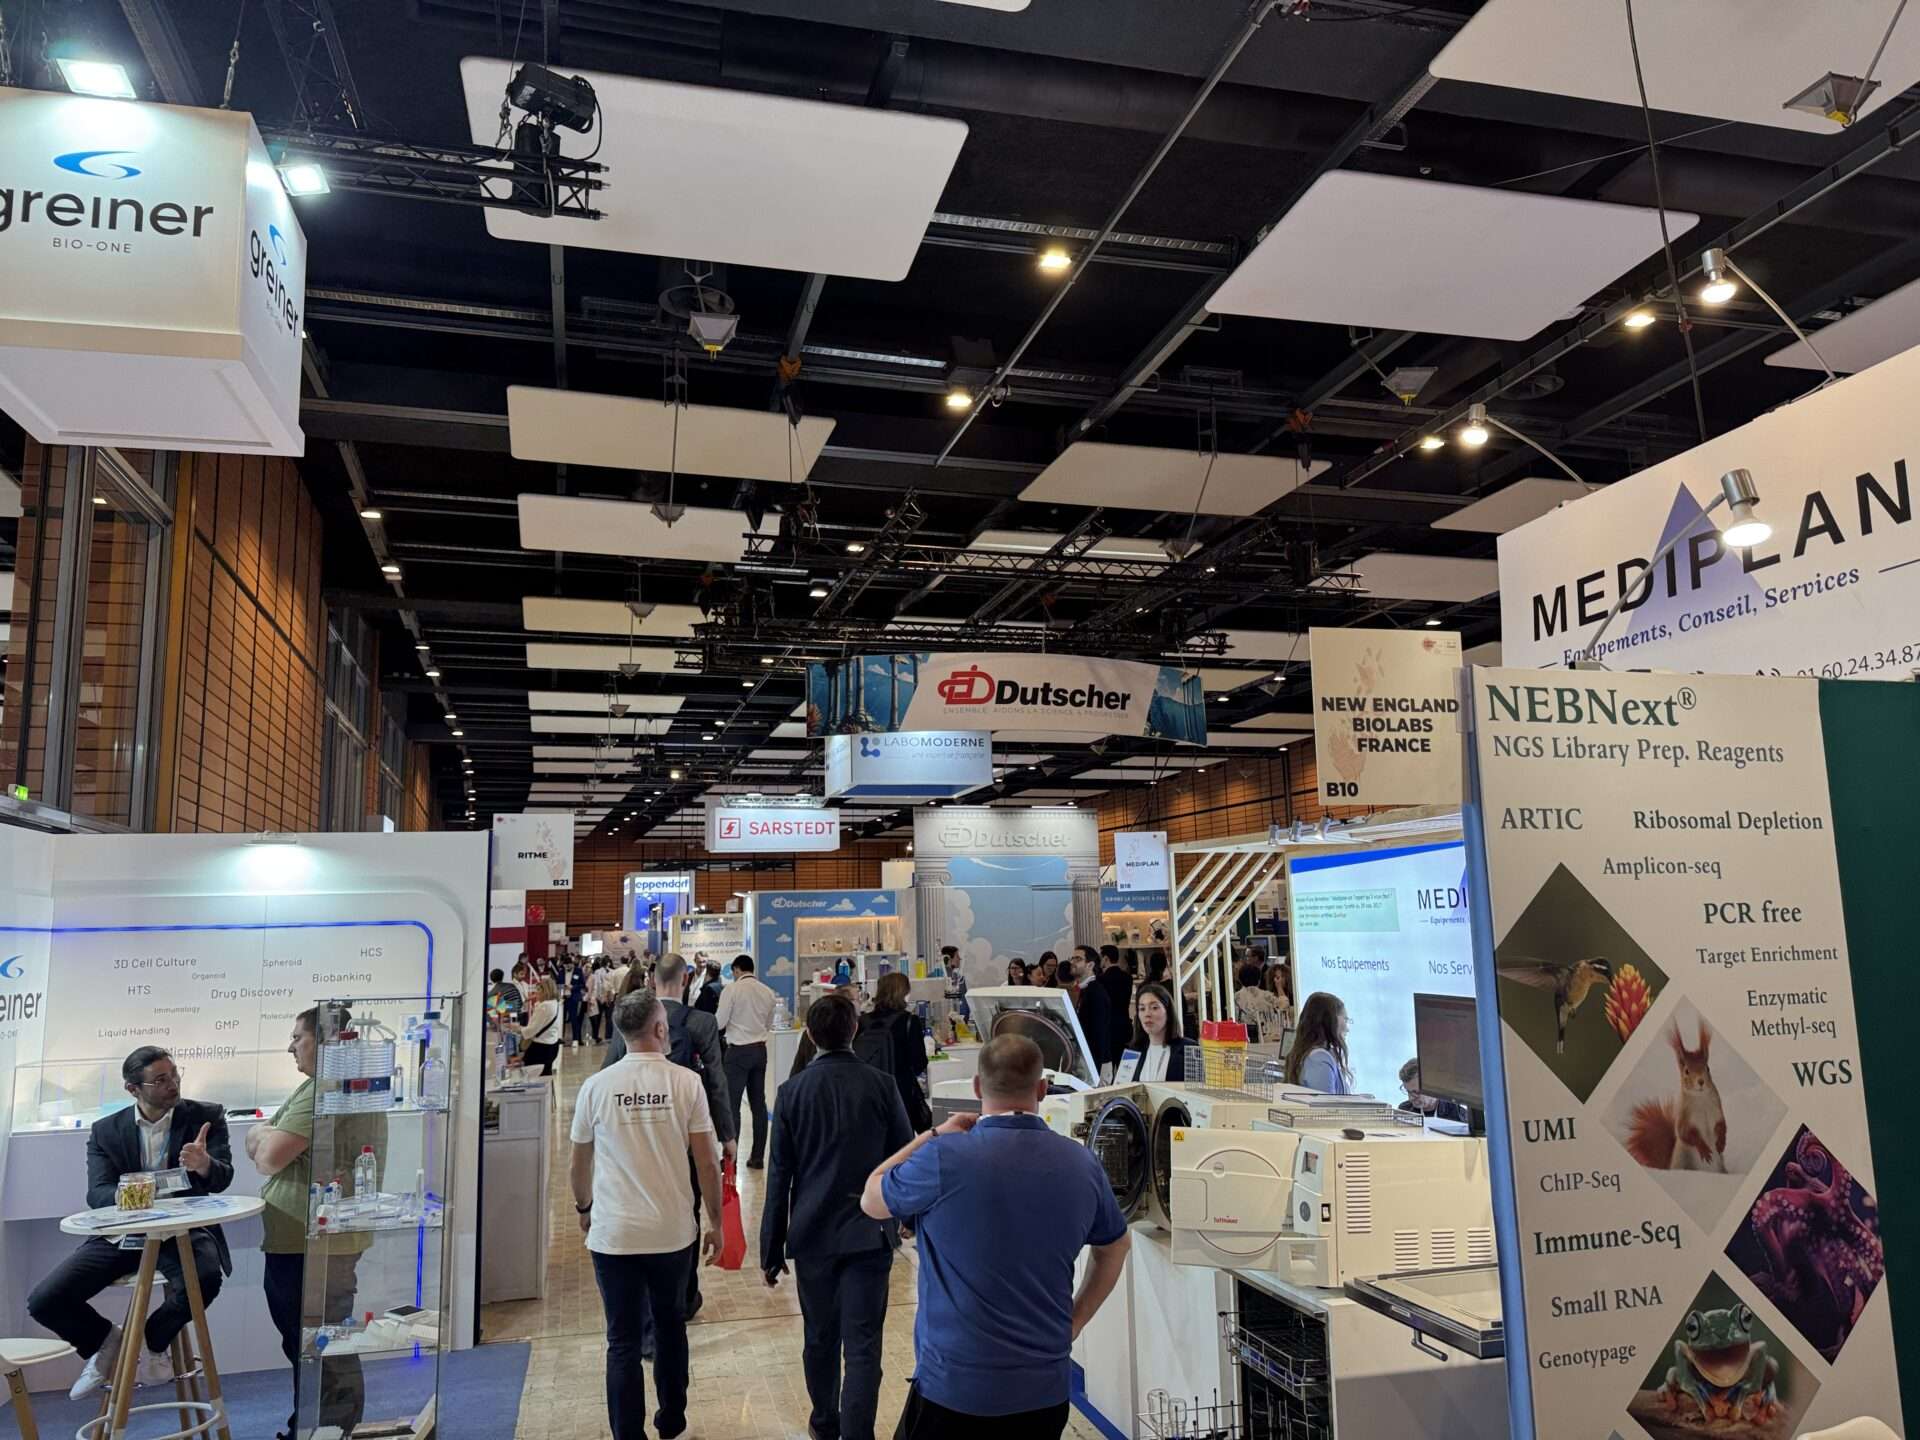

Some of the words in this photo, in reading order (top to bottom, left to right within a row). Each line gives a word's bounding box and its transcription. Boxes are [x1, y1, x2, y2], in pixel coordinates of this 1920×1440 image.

[52, 237, 132, 254] BIO-ONE
[251, 229, 298, 337] greiner
[1532, 458, 1912, 642] MEDIPLAN
[1678, 592, 1758, 634] Conseil,
[1765, 567, 1860, 608] Services
[994, 679, 1131, 711] Dutscher
[1321, 697, 1366, 712] NEW
[1373, 698, 1460, 713] ENGLAND
[1352, 718, 1433, 733] BIOLABS
[1357, 738, 1431, 753] FRANCE
[1493, 736, 1544, 758] NGS
[1552, 736, 1629, 767] Library
[1637, 739, 1689, 768] Prep.
[1697, 740, 1784, 768] Reagents
[1326, 782, 1359, 797] B10
[1501, 807, 1583, 830] ARTIC
[1633, 809, 1731, 830] Ribosomal
[1738, 811, 1823, 835] Depletion
[749, 821, 836, 836] SARSTEDT
[517, 851, 548, 860] RITME
[1602, 857, 1722, 880] Amplicon-seq
[552, 879, 569, 887] B21
[635, 878, 690, 890] eppendorf
[785, 899, 828, 909] Dutscher
[1418, 888, 1468, 910] MEDI
[1704, 902, 1755, 924] PCR
[1762, 900, 1802, 923] free
[360, 947, 383, 958] HCS
[725, 941, 744, 949] comp
[113, 959, 129, 969] 3D
[131, 958, 153, 969] Cell
[155, 957, 197, 968] Culture
[262, 958, 302, 968] Spheroid
[1321, 956, 1336, 969] Nos
[1338, 956, 1390, 972] Equipements
[1695, 948, 1746, 969] Target
[1751, 945, 1839, 963] Enrichment
[1429, 960, 1448, 974] Nos
[1452, 960, 1473, 976] Serv
[312, 972, 372, 984] Biobanking
[128, 984, 151, 996] HTS
[211, 988, 237, 1000] Drug
[240, 986, 294, 999] Discovery
[0, 991, 42, 1021] einer
[1747, 987, 1828, 1011] Enzymatic
[98, 1028, 127, 1038] Liquid
[129, 1025, 170, 1037] Handling
[215, 1020, 239, 1031] GMP
[1751, 1017, 1837, 1040] Methyl-seq
[1791, 1059, 1853, 1088] WGS
[615, 1092, 669, 1107] Telstar
[1523, 1117, 1577, 1143] UMI
[1540, 1170, 1621, 1194] ChIP-Seq
[1534, 1220, 1682, 1255] Immune-Seq
[1551, 1288, 1607, 1318] Small
[1615, 1285, 1663, 1308] RNA
[1538, 1343, 1637, 1370] Genotypage
